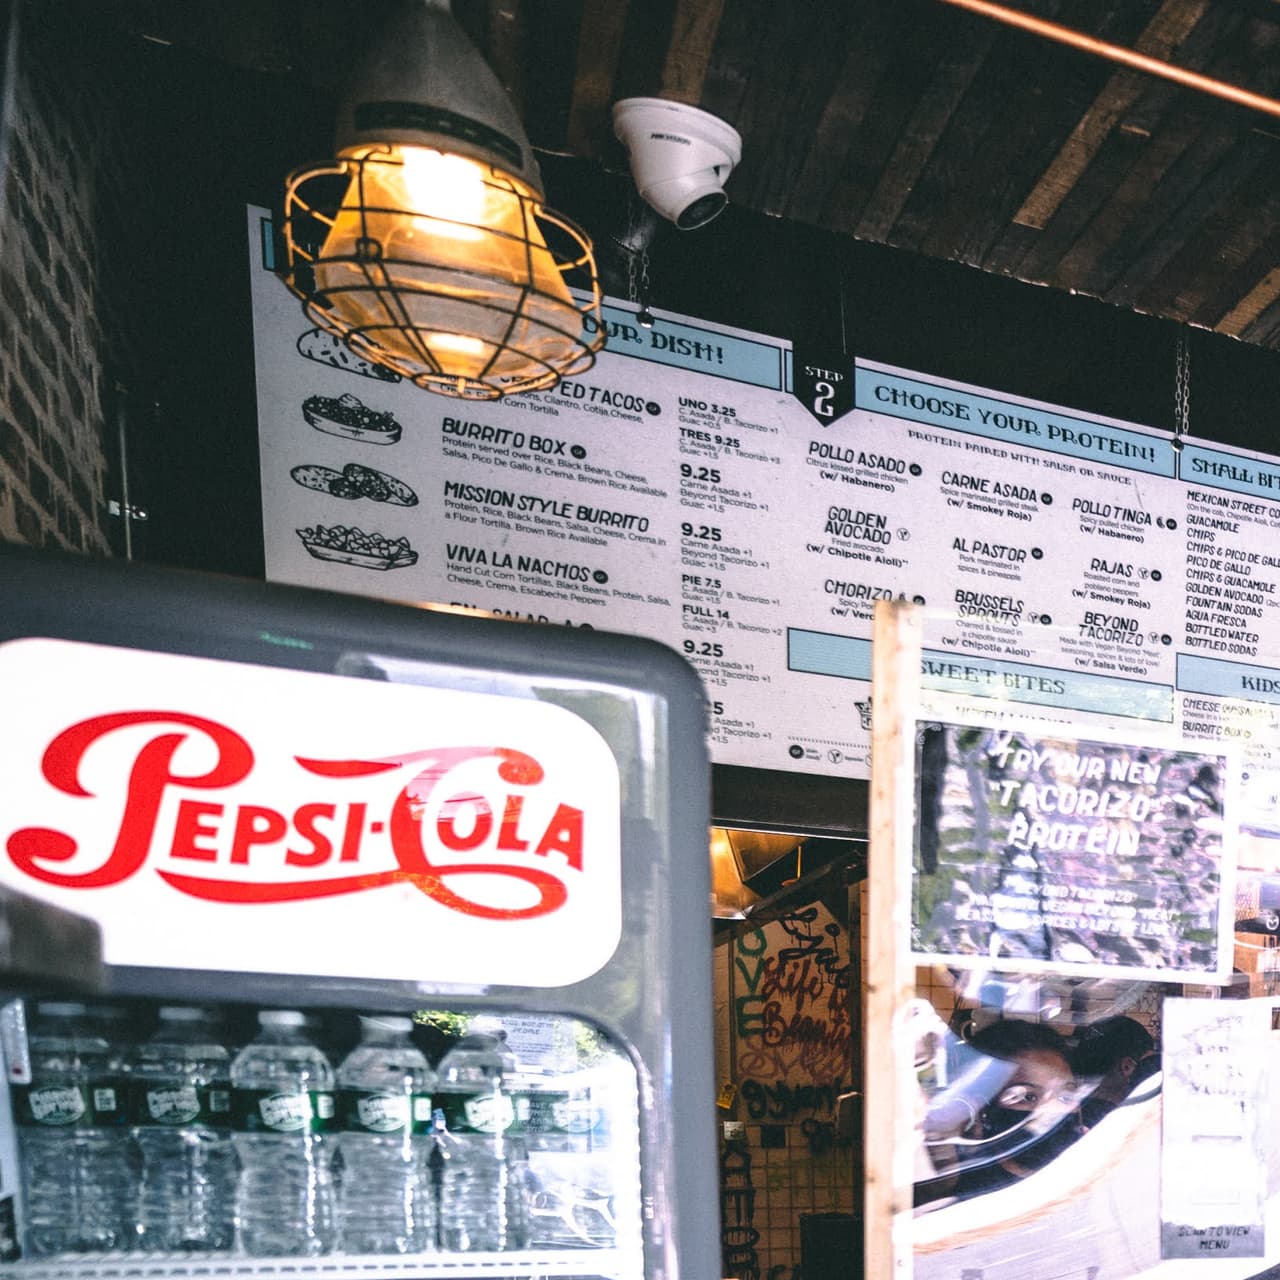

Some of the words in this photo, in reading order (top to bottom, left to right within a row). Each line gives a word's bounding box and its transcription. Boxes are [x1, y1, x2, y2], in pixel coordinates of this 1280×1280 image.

[651, 331, 724, 365] DISH!
[804, 365, 845, 383] STEP
[589, 384, 646, 412] TACOS
[678, 397, 707, 412] UNO
[709, 403, 738, 418] 3.25
[814, 381, 835, 417] 2
[441, 417, 526, 448] BURRITO
[528, 429, 568, 456] BOX
[874, 385, 971, 421] CHOOSE
[978, 407, 1041, 436] YOUR
[1047, 424, 1157, 462] PROTEIN!
[679, 426, 712, 443] TRES
[714, 433, 742, 449] 9.25
[808, 440, 855, 465] POLLO
[857, 452, 907, 476] ASADO
[907, 430, 962, 449] PROTEIN
[966, 441, 1008, 459] PAIRED
[1011, 452, 1041, 467] WITH
[1043, 459, 1076, 475] SALSA
[1079, 467, 1095, 478] OR
[1096, 471, 1132, 487] SAUCE
[1190, 456, 1254, 485] SMALL
[680, 463, 722, 485] 9.25
[941, 470, 991, 495] CARNE
[992, 482, 1038, 504] ASADA
[443, 480, 516, 509] MISSION
[516, 494, 574, 520] STYLE
[575, 504, 650, 533] BURRITO
[1072, 497, 1113, 519] POLLO
[1112, 505, 1153, 527] TINGA
[1186, 489, 1230, 509] MEXICAN
[1230, 499, 1268, 516] STREET
[827, 505, 888, 530] GOLDEN
[1185, 513, 1241, 534] GUACAMOLE
[681, 522, 722, 543] 9.25
[823, 521, 893, 546] AVOCADO
[445, 543, 489, 566] VIVA
[491, 550, 515, 571] LA
[516, 556, 592, 583] NACHOS
[952, 536, 972, 554] AL
[972, 540, 1028, 565] PASTOR
[1090, 557, 1135, 580] RAJAS
[681, 603, 712, 619] FULL
[715, 609, 730, 621] 14
[954, 589, 1026, 615] BRUSSELS
[1185, 596, 1233, 614] FOUNTAIN
[1233, 602, 1264, 619] SODAS
[957, 604, 1022, 627] SPROUTS
[1084, 610, 1140, 633] BEYOND
[1078, 622, 1145, 647] TACORIZO
[682, 639, 725, 659] 9.25
[998, 747, 1048, 772] TRY
[1054, 755, 1106, 781] OUR
[1110, 760, 1163, 787] NEW
[1007, 820, 1141, 857] PROTEIN
